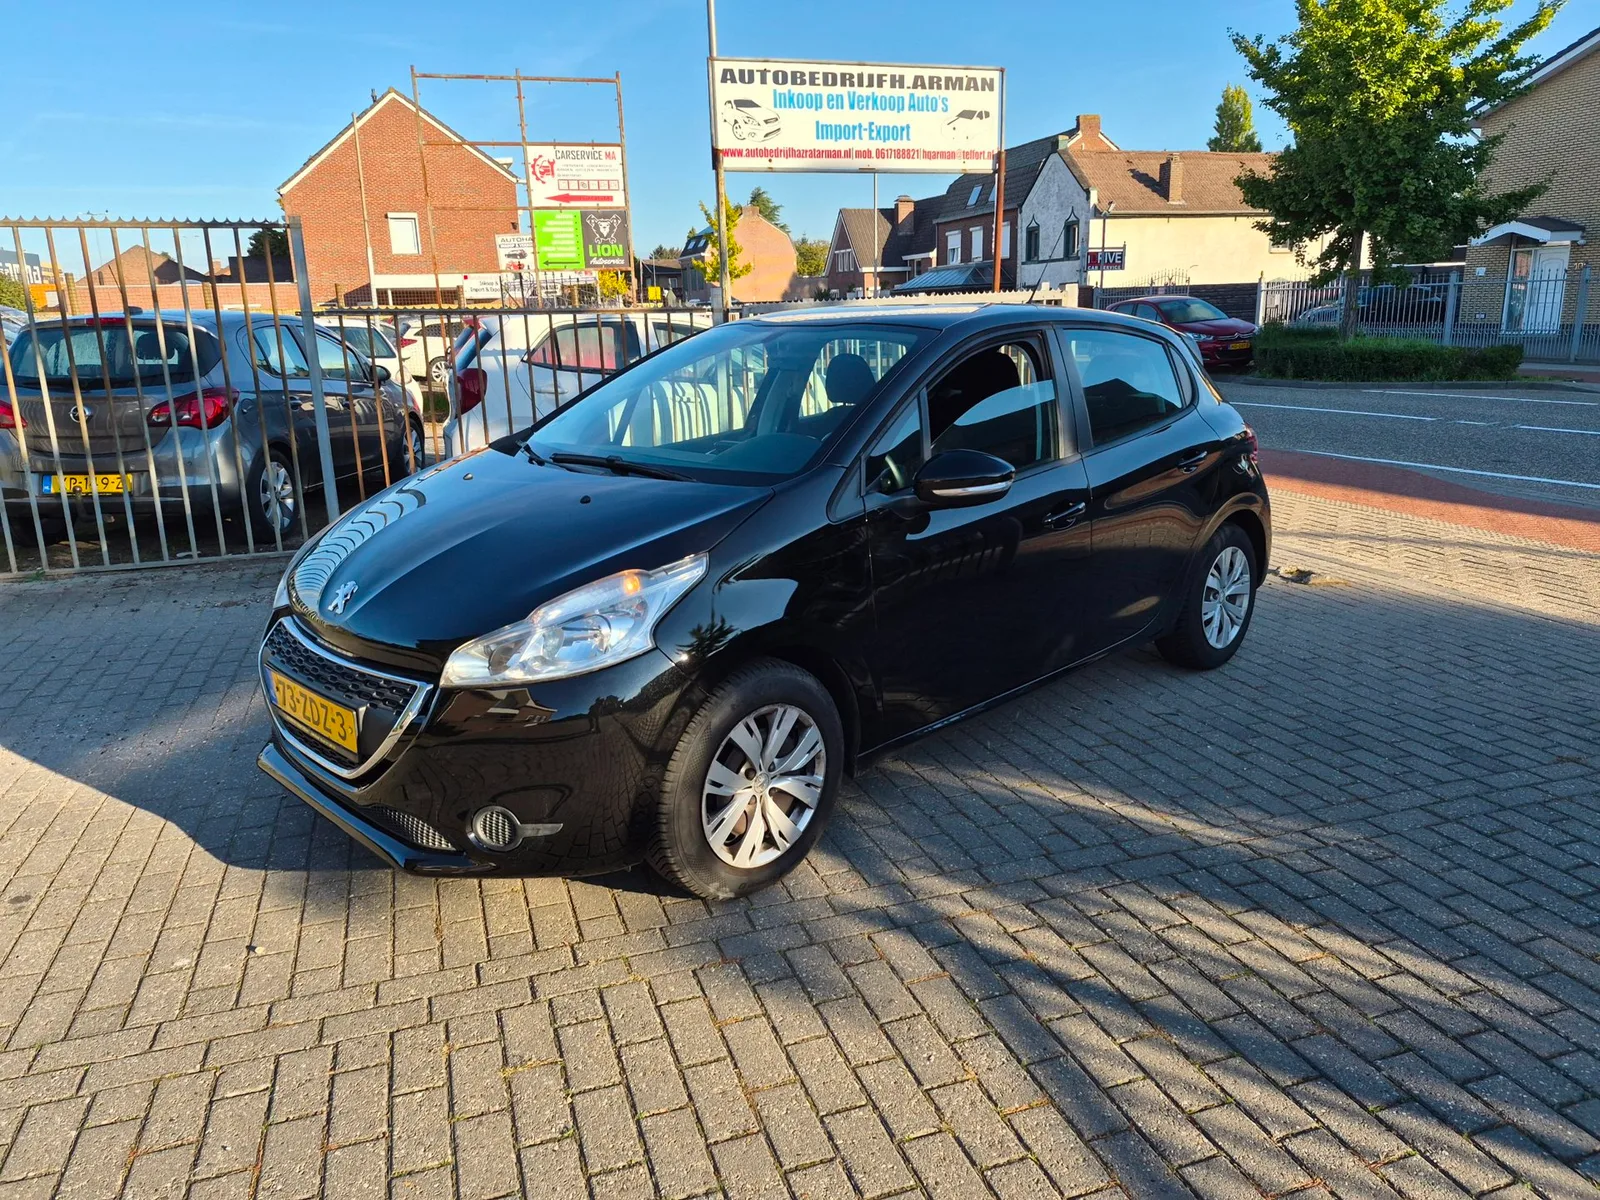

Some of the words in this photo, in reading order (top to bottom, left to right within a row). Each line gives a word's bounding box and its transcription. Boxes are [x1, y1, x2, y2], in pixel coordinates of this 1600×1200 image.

[773, 89, 823, 111] Inkoop
[827, 93, 844, 110] en
[847, 91, 905, 114] Verkoop
[908, 93, 949, 112] Auto's
[815, 120, 911, 143] Import-Export
[555, 150, 603, 161] CARSERVICE
[604, 151, 617, 161] MA
[588, 244, 624, 257] LION
[589, 257, 625, 266] Autoservice
[277, 679, 347, 741] 73-ZDZ-3
